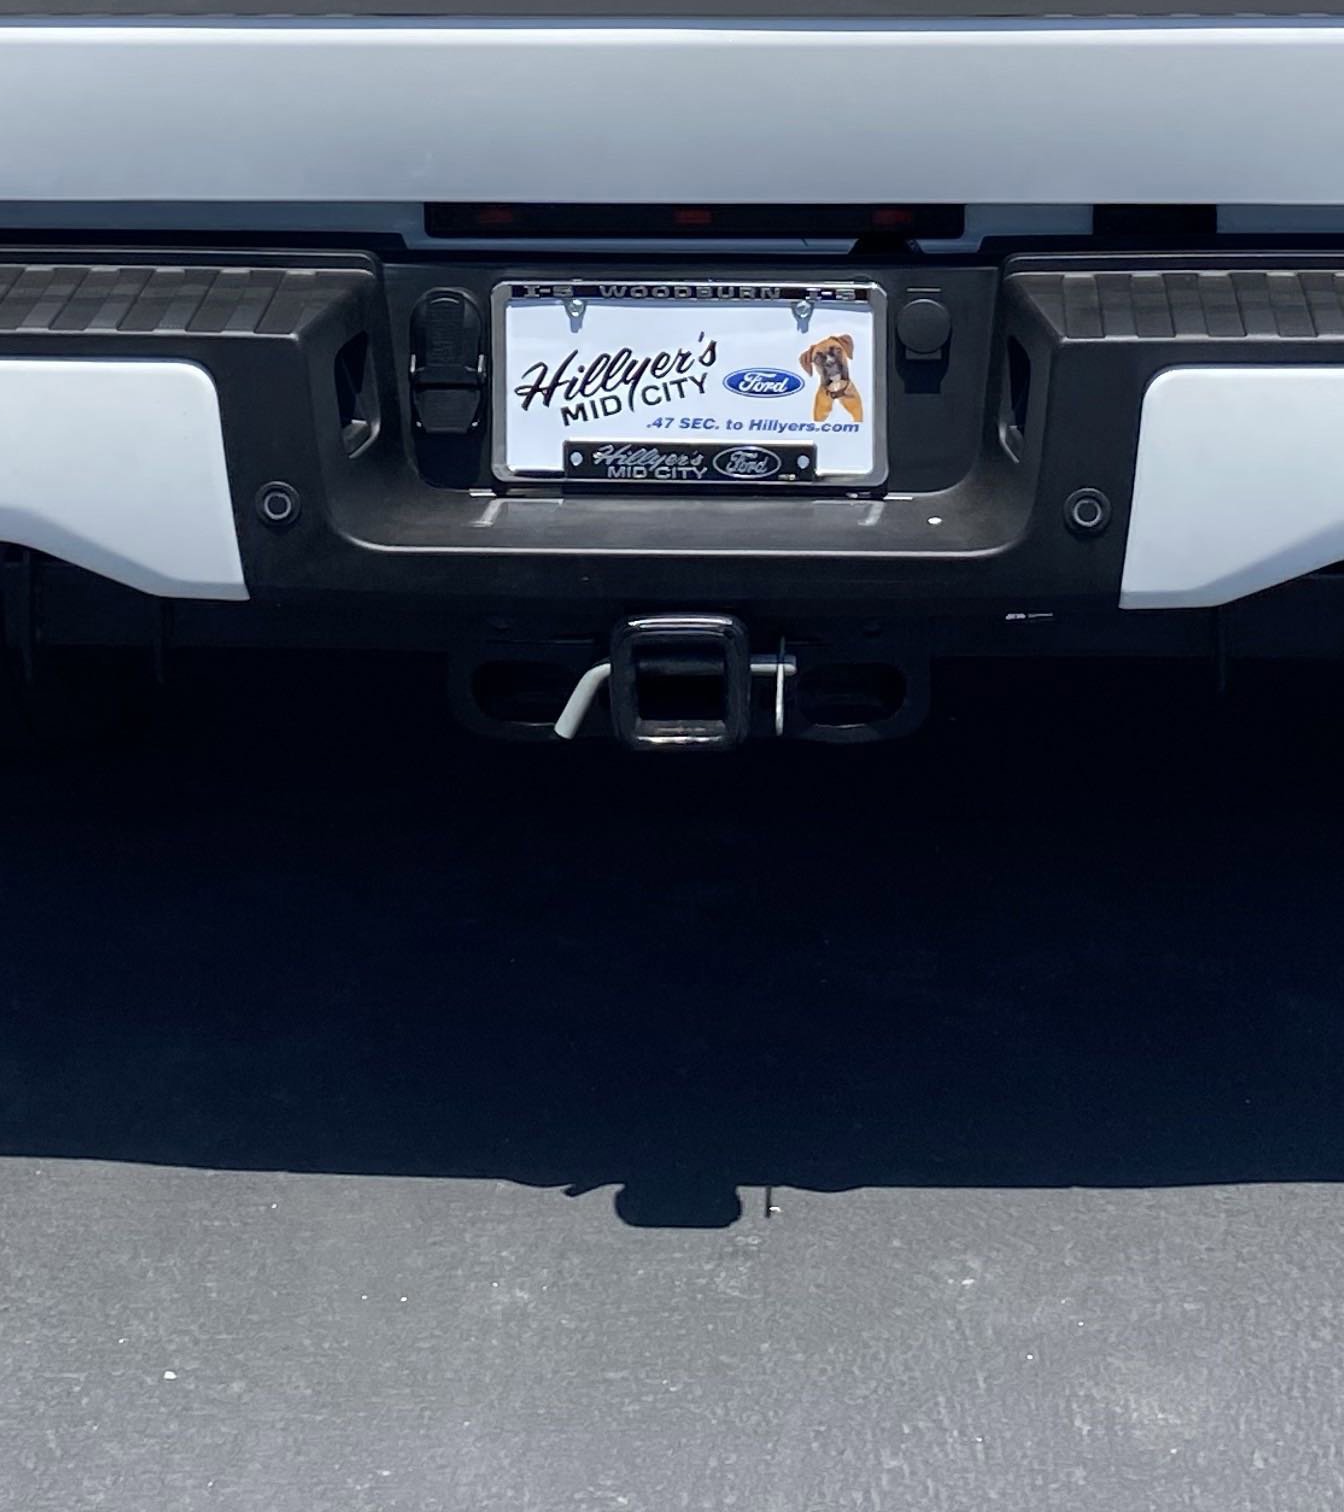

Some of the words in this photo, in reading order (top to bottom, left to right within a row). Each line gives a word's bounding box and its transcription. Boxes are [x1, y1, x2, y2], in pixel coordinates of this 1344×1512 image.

[599, 285, 781, 299] WOODBURN
[514, 330, 718, 413] Hillyer's
[560, 395, 623, 427] MID
[641, 372, 709, 407] CITY
[646, 417, 674, 430] .47
[679, 417, 720, 430] SEC.
[725, 419, 743, 431] to
[748, 419, 860, 434] Hillyers.com
[592, 444, 705, 471] Hillyer's
[607, 466, 648, 480] MID
[655, 466, 708, 480] CITY
